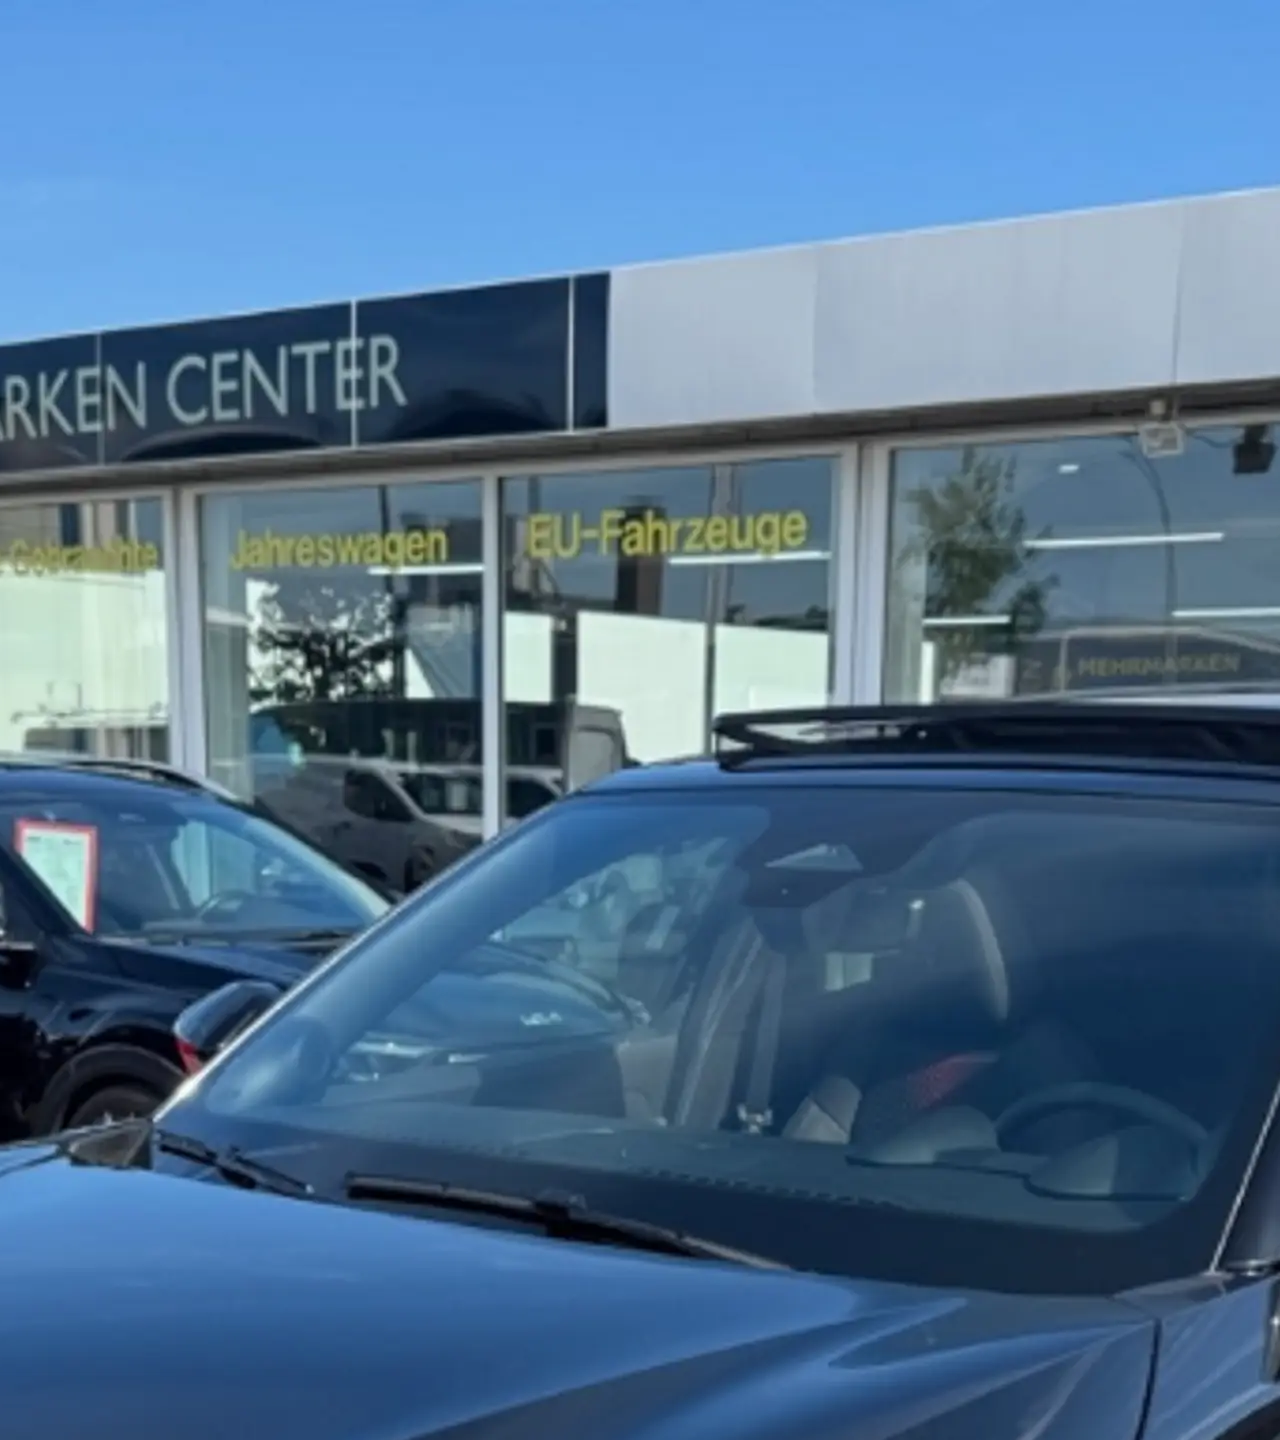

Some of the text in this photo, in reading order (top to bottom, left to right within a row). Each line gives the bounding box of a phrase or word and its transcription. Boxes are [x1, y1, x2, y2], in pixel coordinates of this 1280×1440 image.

[166, 333, 409, 425] CENTER
[230, 527, 448, 571] Jahreswagen
[527, 508, 808, 558] EU-Fahrzeuge
